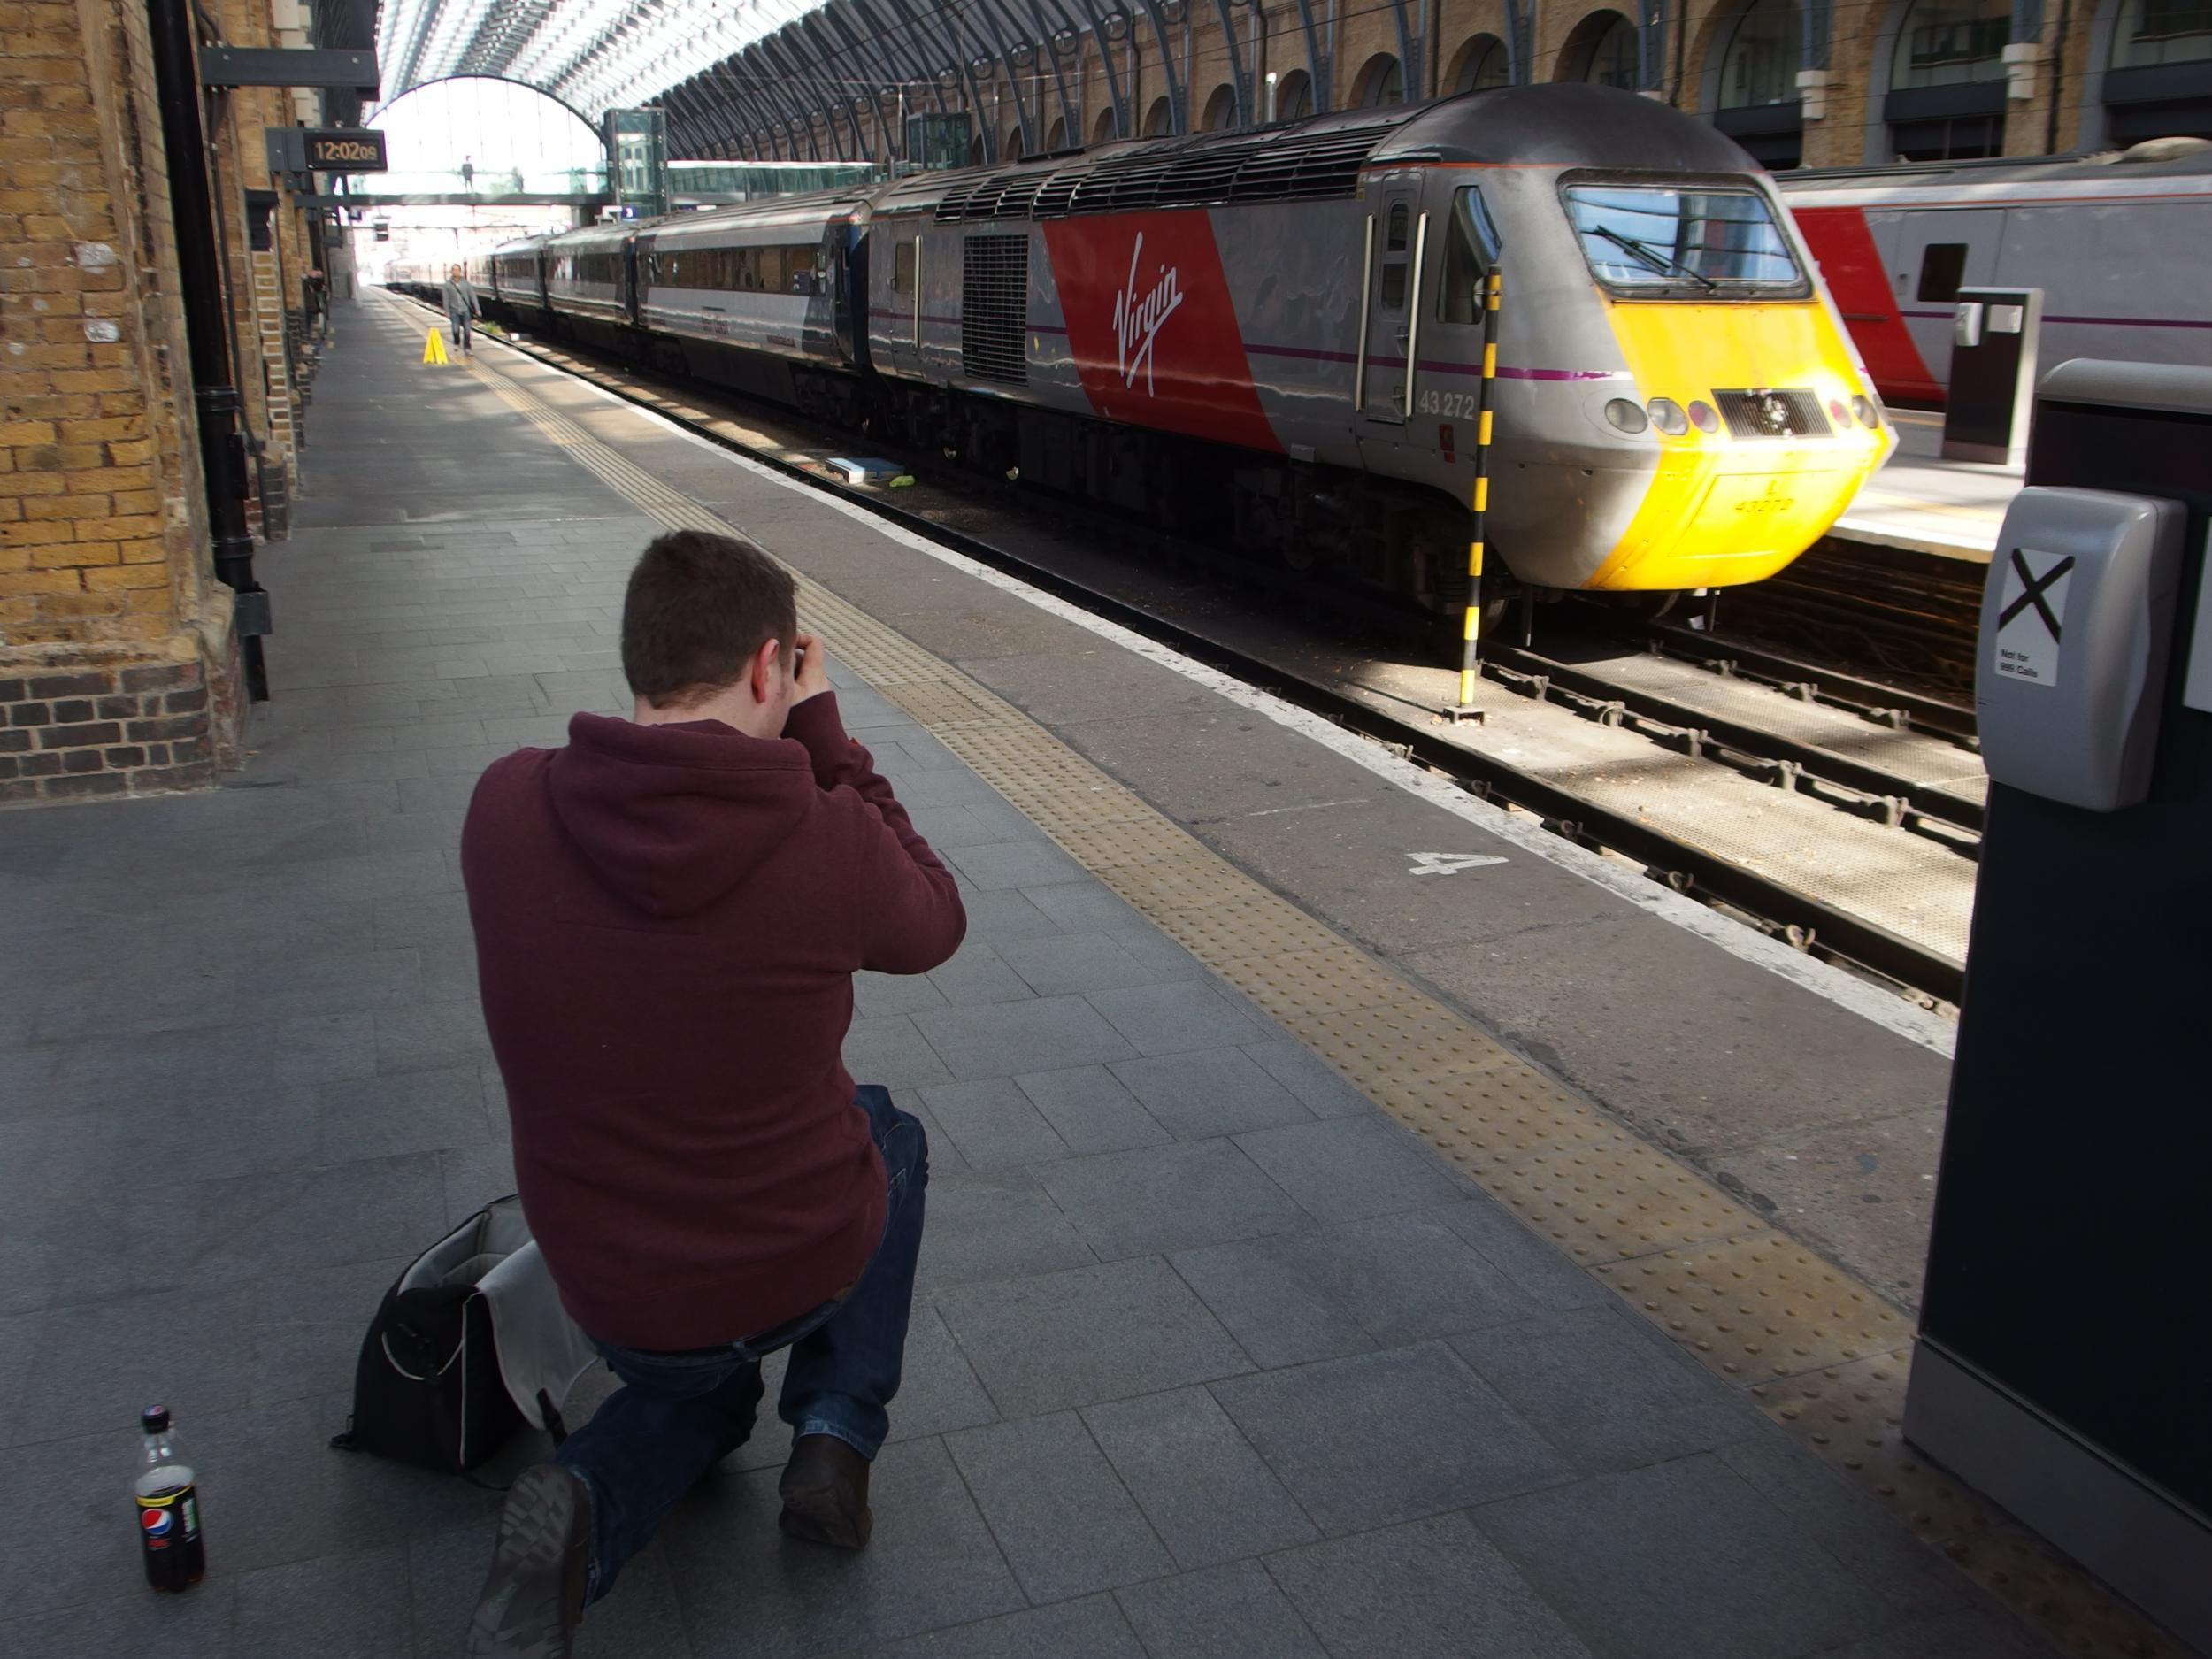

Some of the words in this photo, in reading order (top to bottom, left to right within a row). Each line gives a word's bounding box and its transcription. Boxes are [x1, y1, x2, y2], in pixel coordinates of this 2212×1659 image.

[1112, 234, 1184, 397] Virgin
[1420, 390, 1440, 414] 43
[1444, 392, 1475, 419] 272
[1734, 496, 1793, 512] 43272
[2001, 649, 2016, 660] Not
[2017, 652, 2030, 662] for
[2017, 665, 2039, 678] Calls
